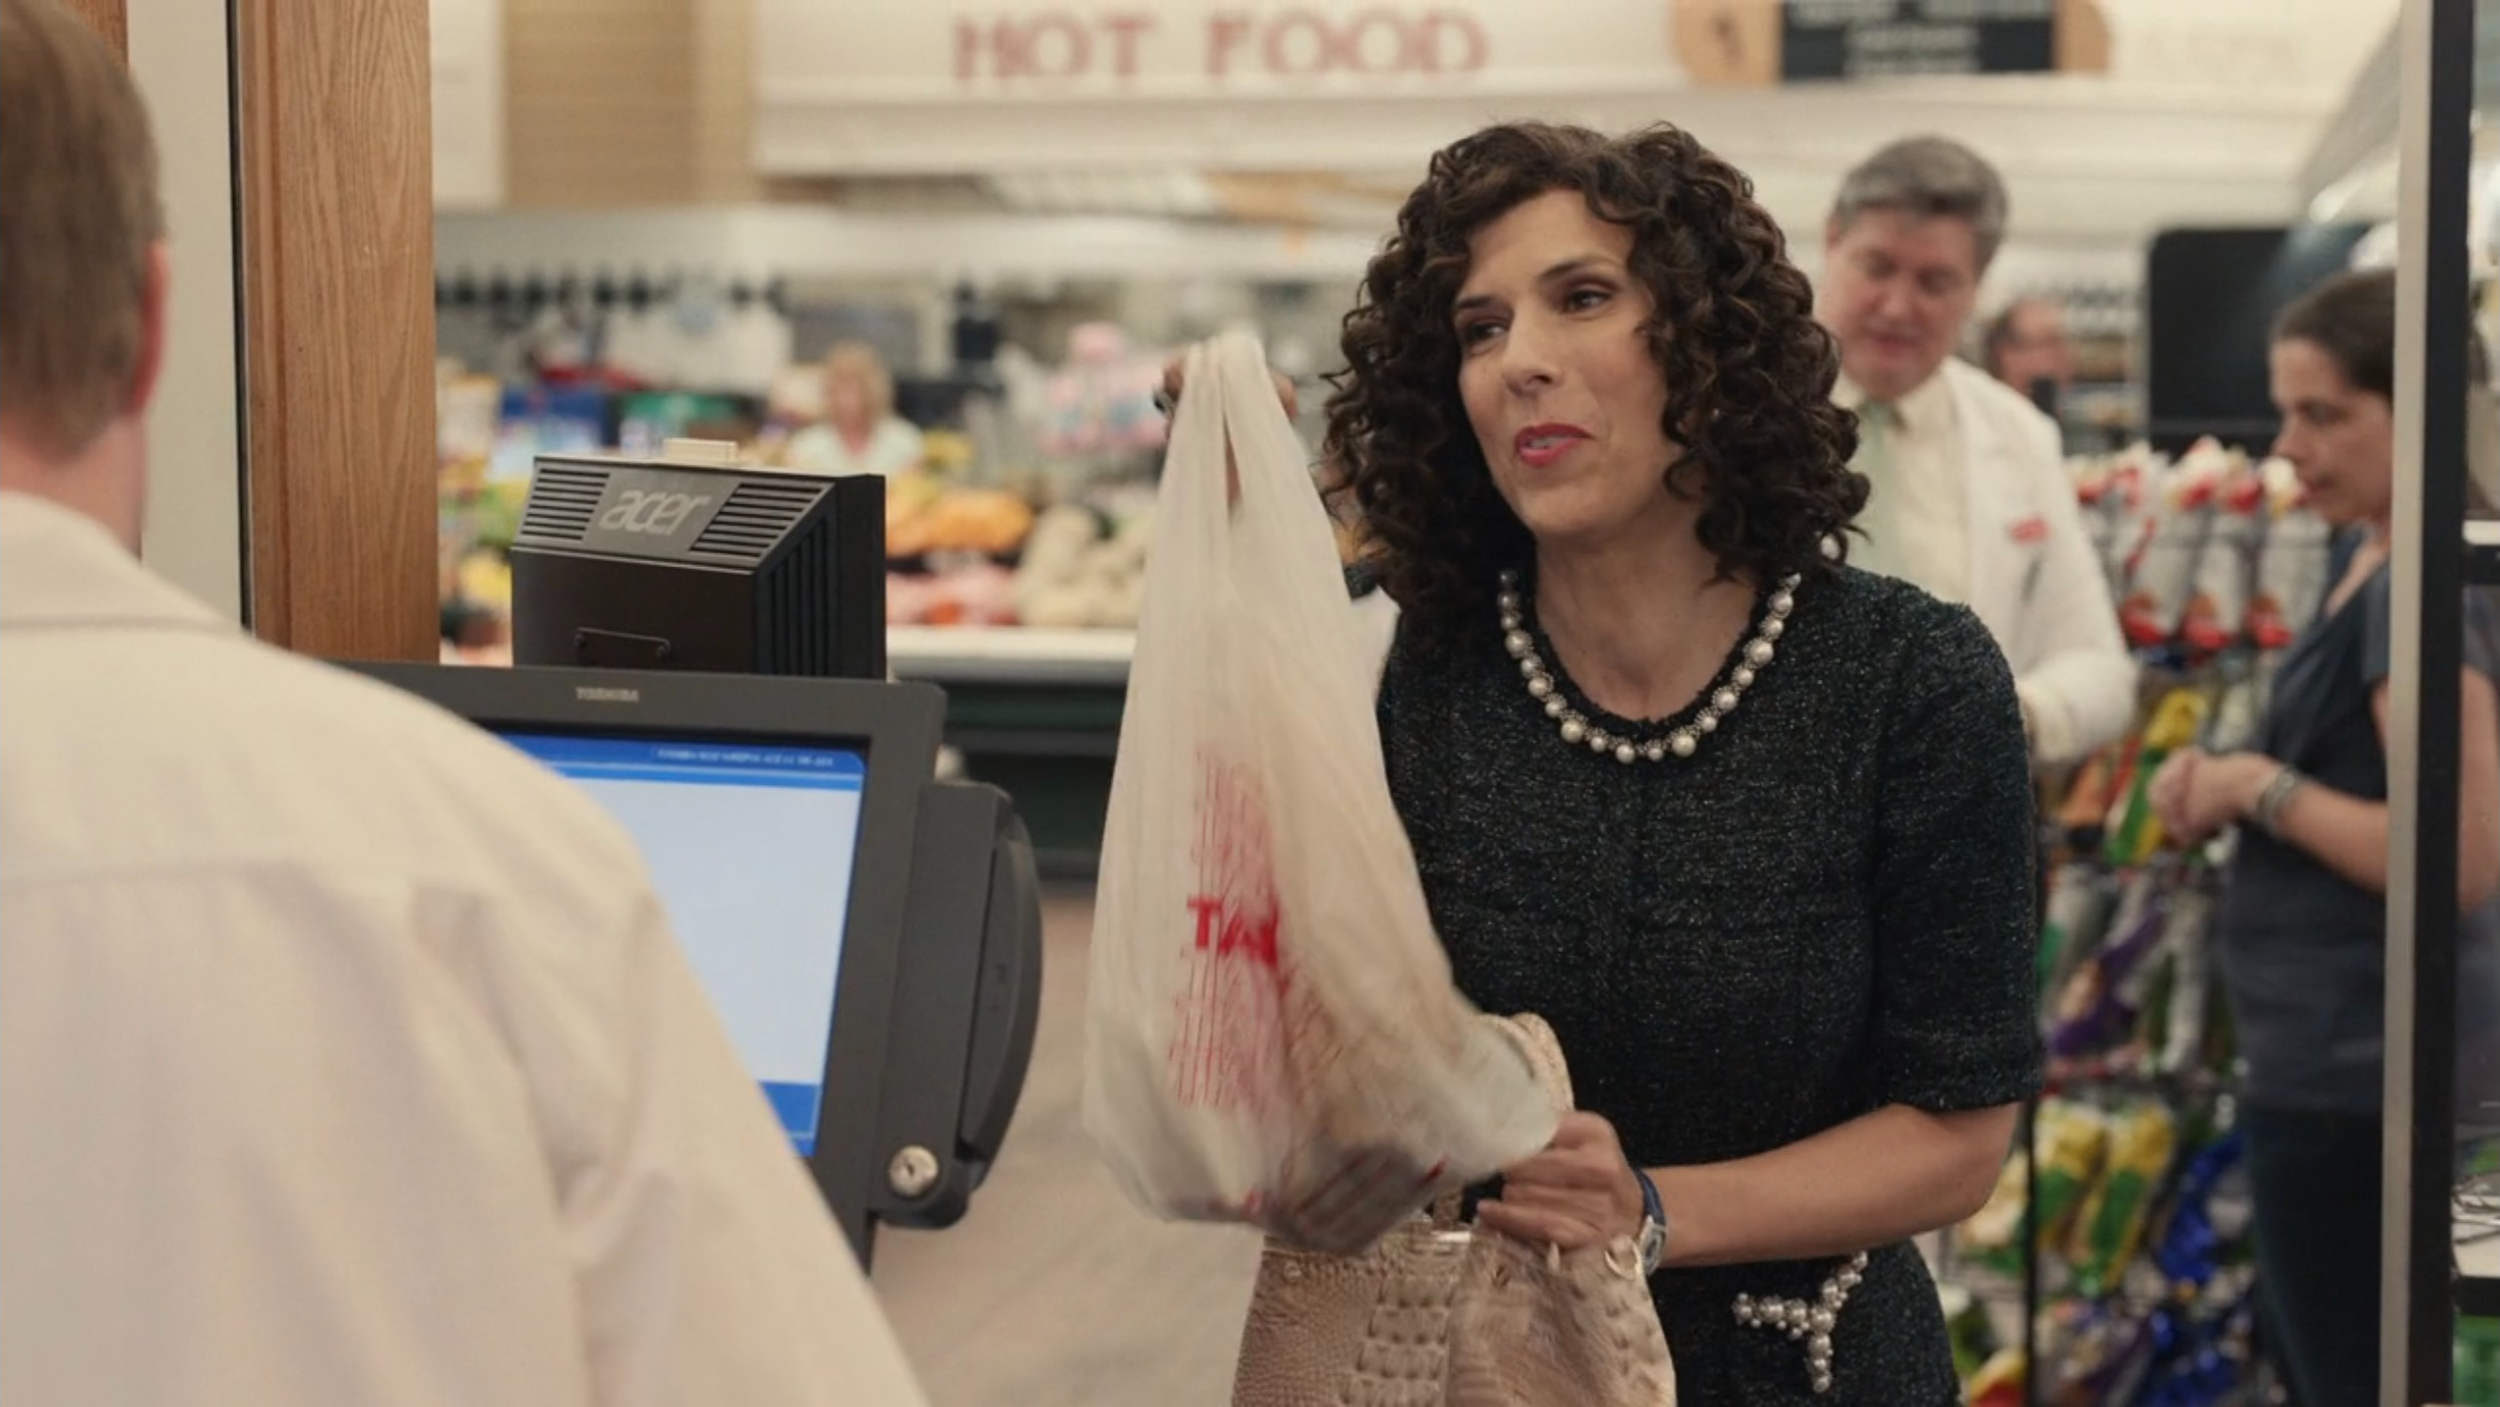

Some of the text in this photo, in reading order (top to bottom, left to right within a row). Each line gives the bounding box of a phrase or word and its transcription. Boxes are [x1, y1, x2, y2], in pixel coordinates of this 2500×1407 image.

[952, 8, 1489, 80] HOT FOOD
[599, 490, 712, 535] acer
